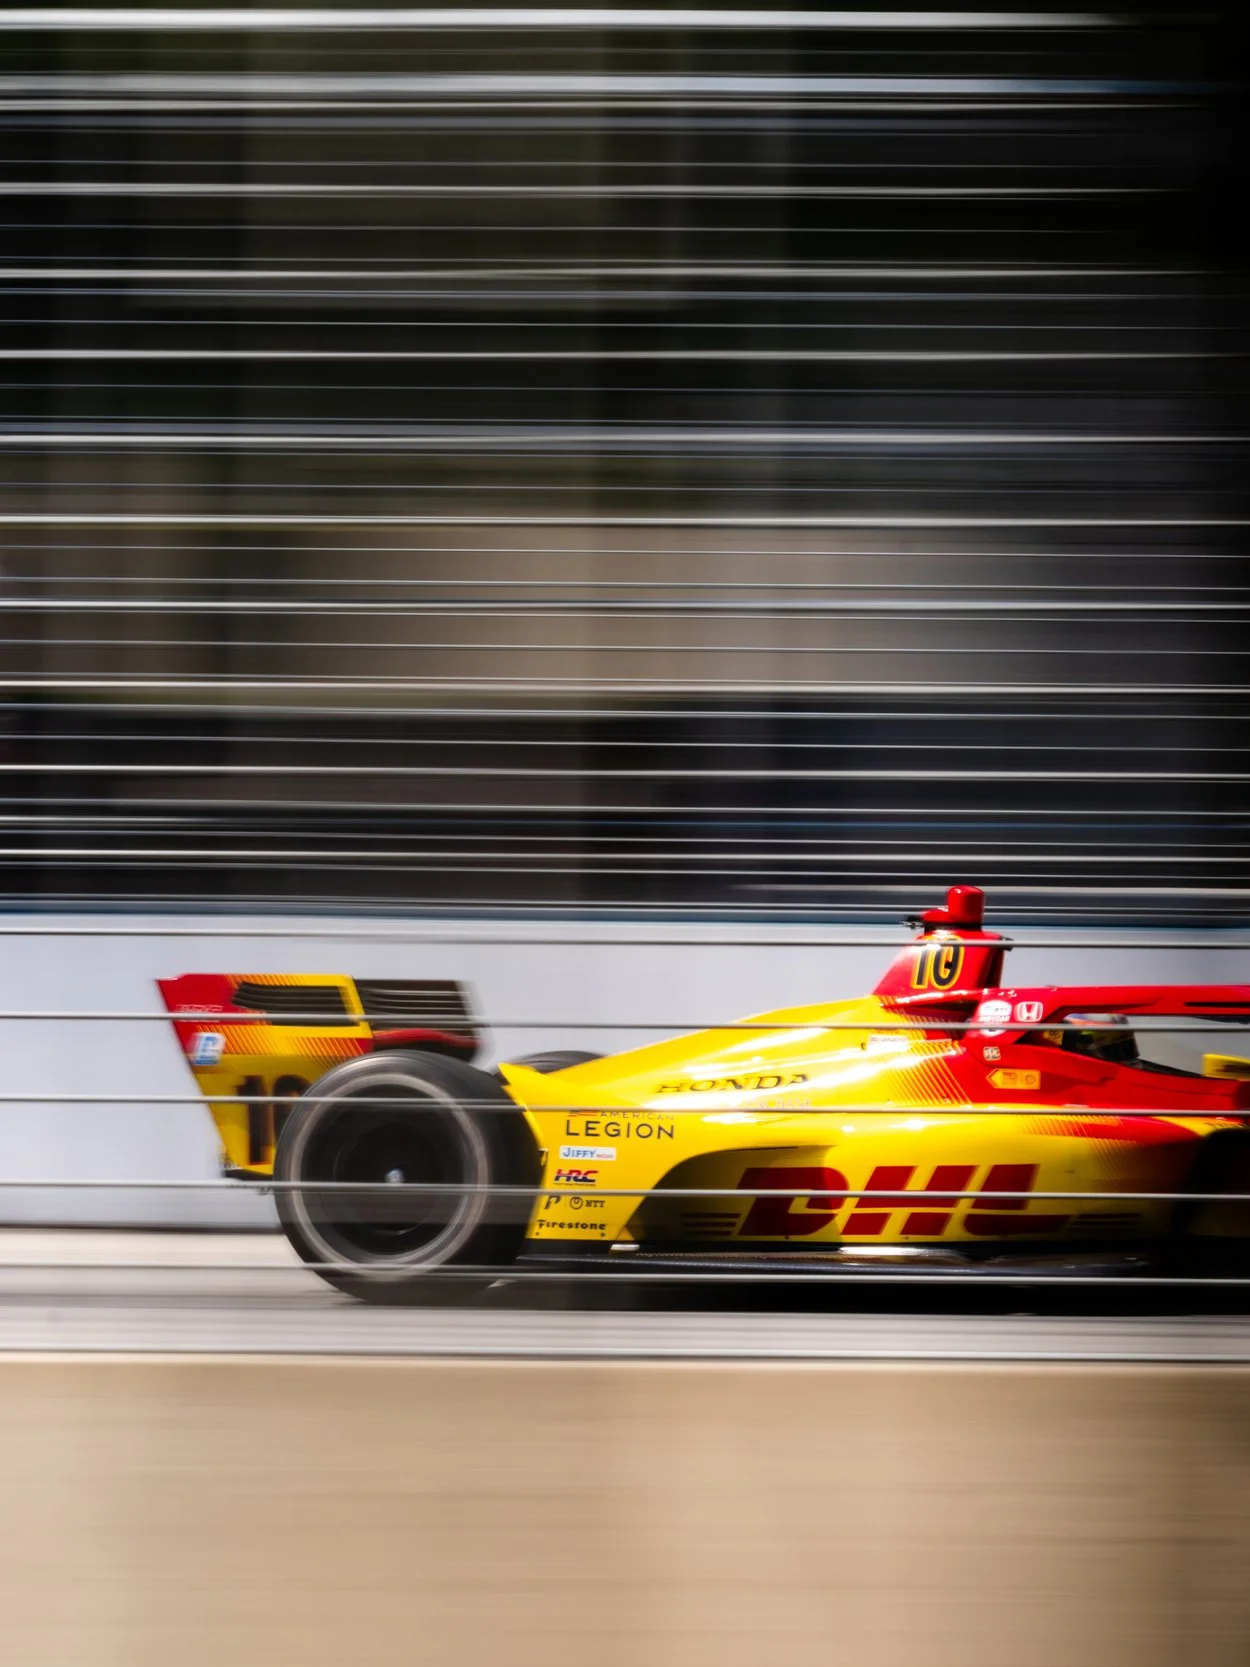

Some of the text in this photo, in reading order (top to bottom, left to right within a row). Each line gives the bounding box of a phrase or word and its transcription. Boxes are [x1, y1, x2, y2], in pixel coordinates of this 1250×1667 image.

[912, 936, 964, 989] 10
[655, 1073, 809, 1093] HONDA
[600, 1110, 676, 1121] AMERICAN
[565, 1119, 675, 1139] LEGION
[554, 1168, 599, 1183] HRC
[585, 1199, 606, 1208] NTT
[737, 1164, 1073, 1236] DHL
[537, 1219, 607, 1230] Firestone
